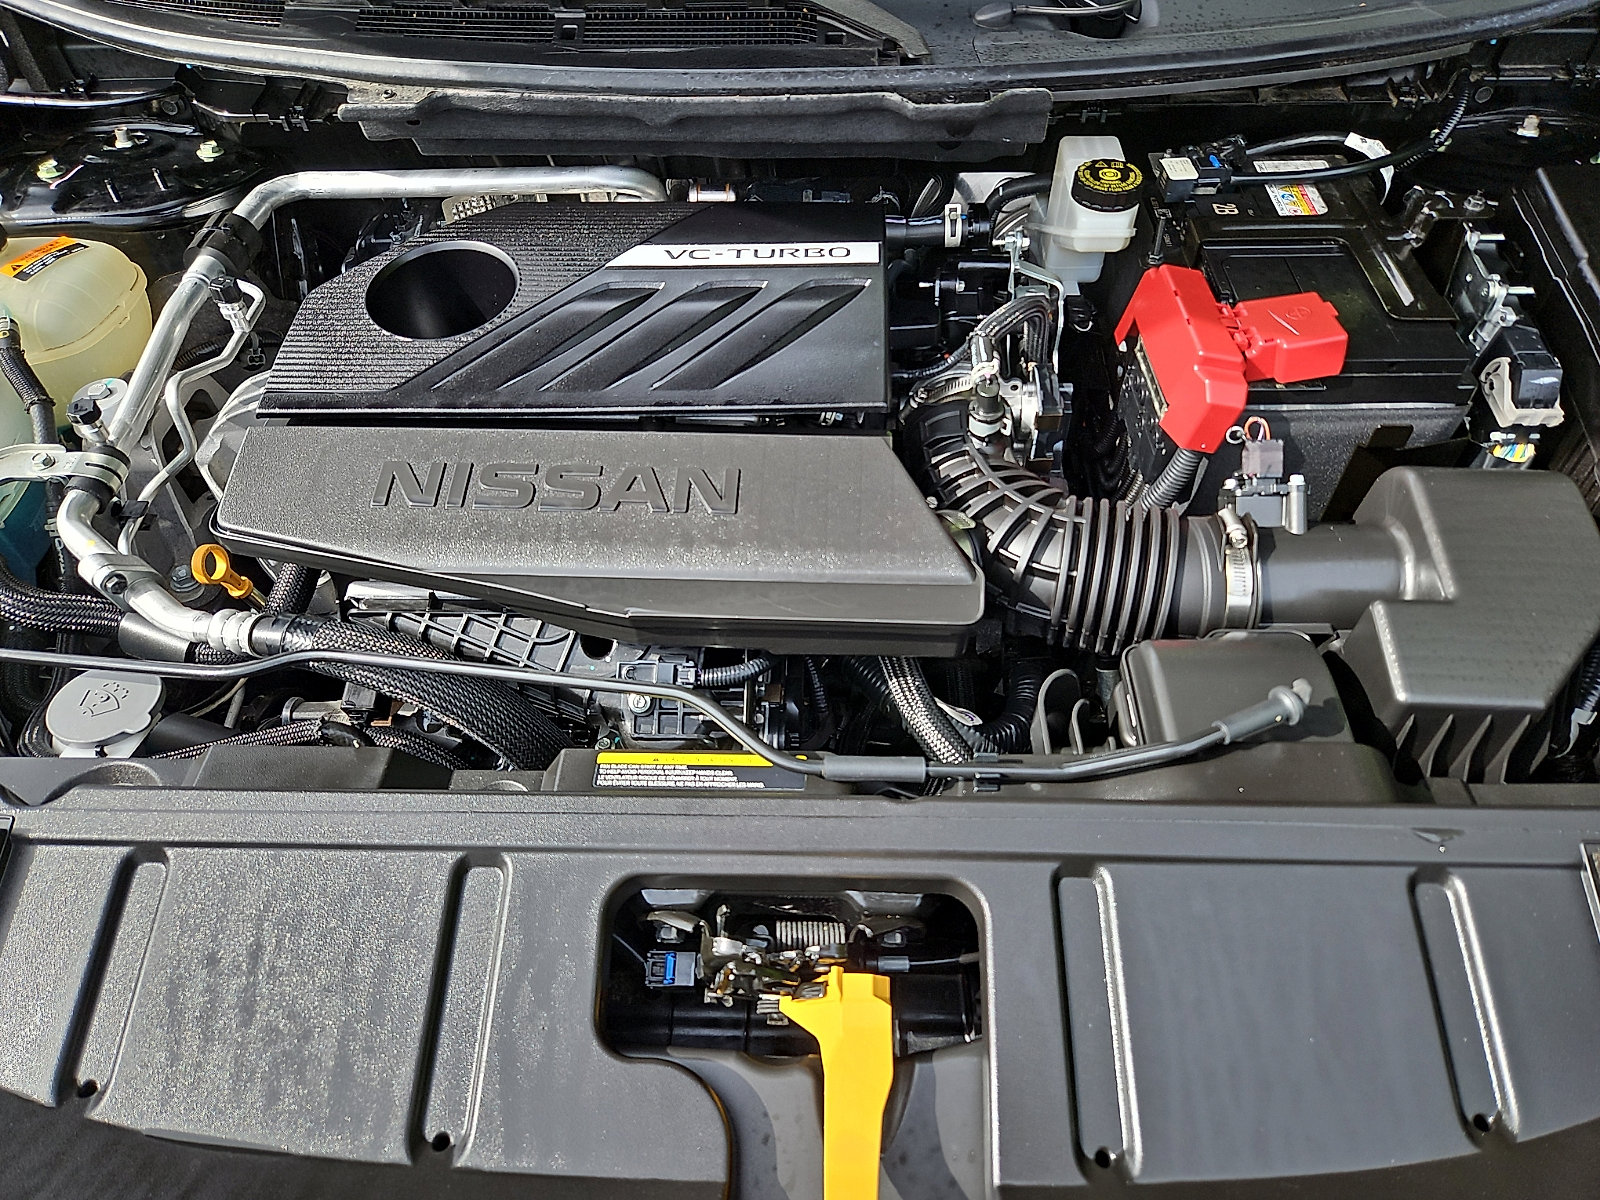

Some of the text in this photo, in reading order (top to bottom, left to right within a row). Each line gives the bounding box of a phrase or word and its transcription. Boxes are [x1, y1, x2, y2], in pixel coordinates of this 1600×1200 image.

[1211, 203, 1239, 215] 2B
[664, 247, 851, 260] VC-TURBO
[370, 461, 741, 514] NISSAN
